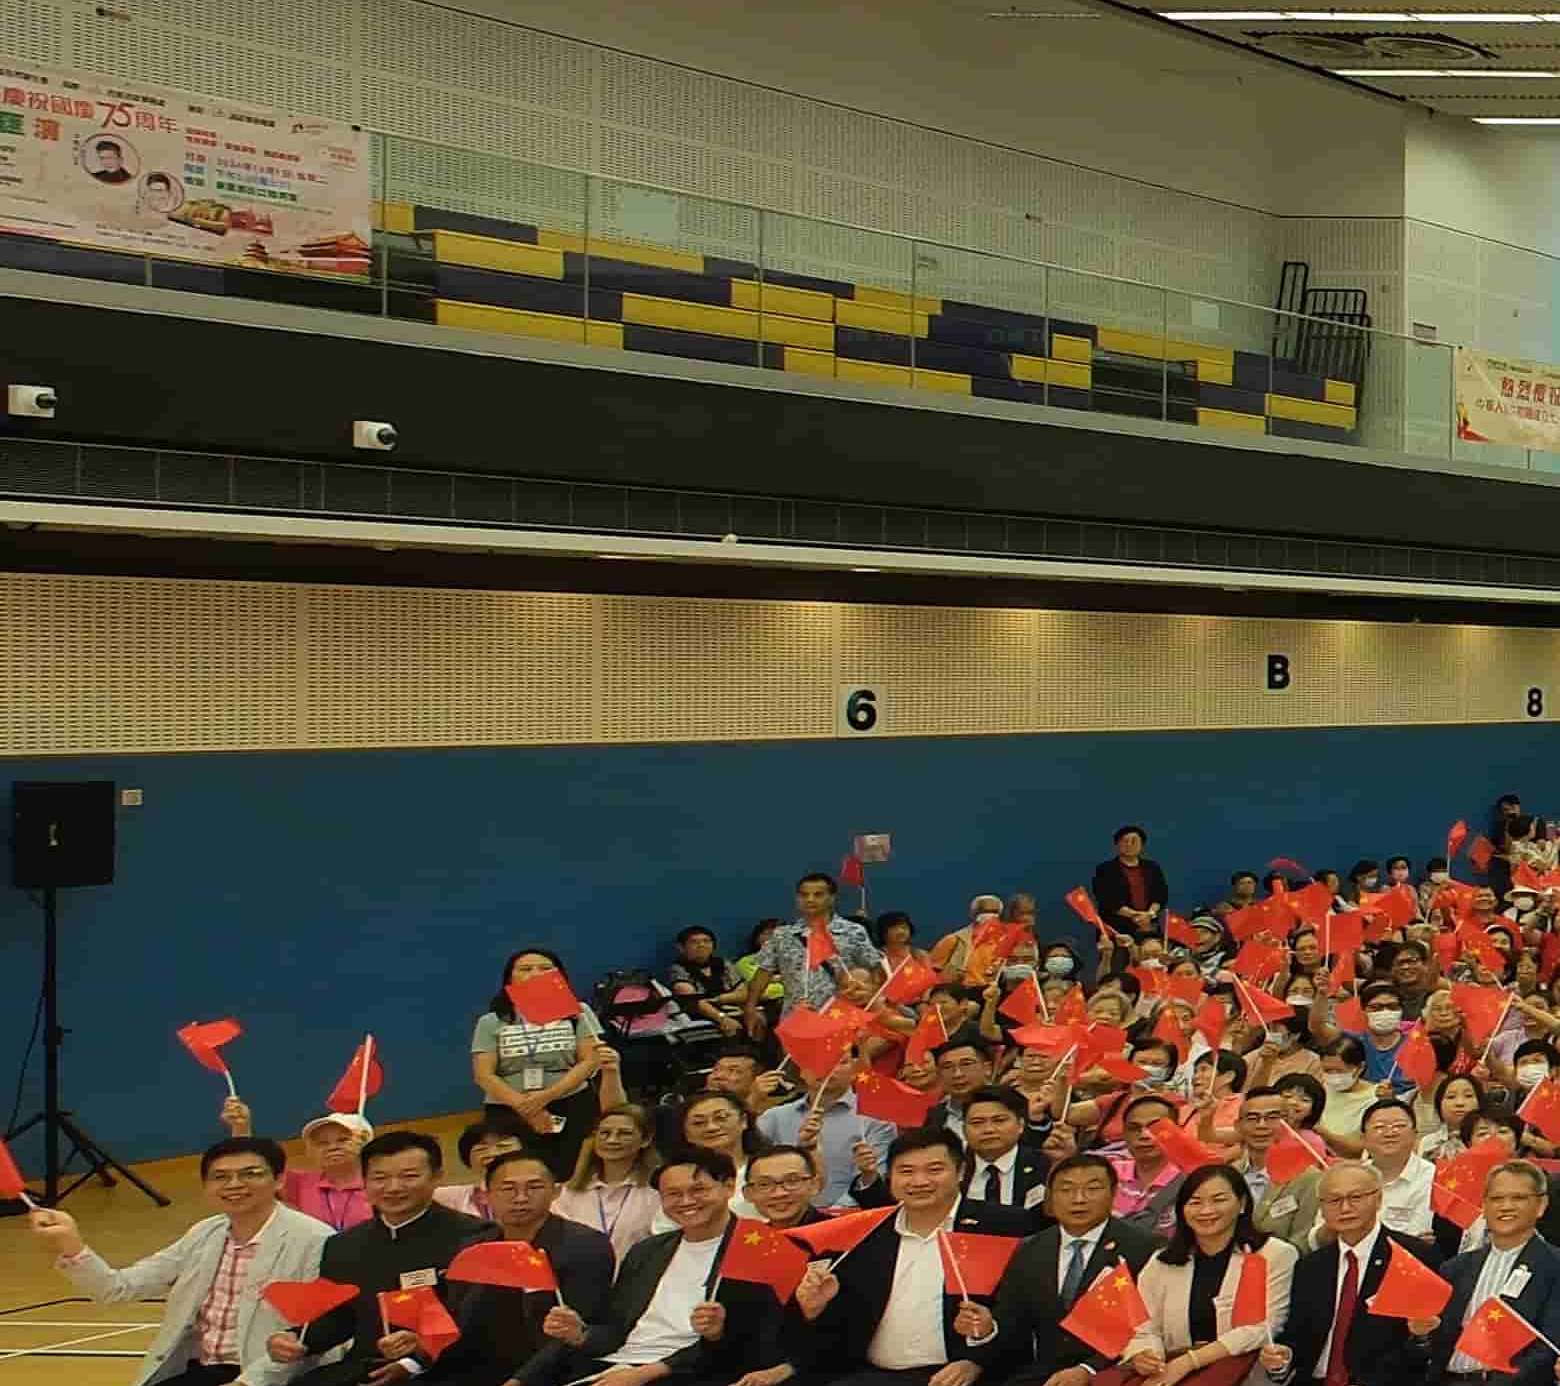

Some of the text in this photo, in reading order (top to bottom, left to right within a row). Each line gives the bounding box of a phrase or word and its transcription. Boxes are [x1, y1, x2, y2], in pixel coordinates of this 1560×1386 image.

[0, 86, 178, 134] 慶祝國慶75周年
[1267, 654, 1290, 689] B
[847, 689, 877, 731] 6
[1527, 687, 1543, 717] 8
